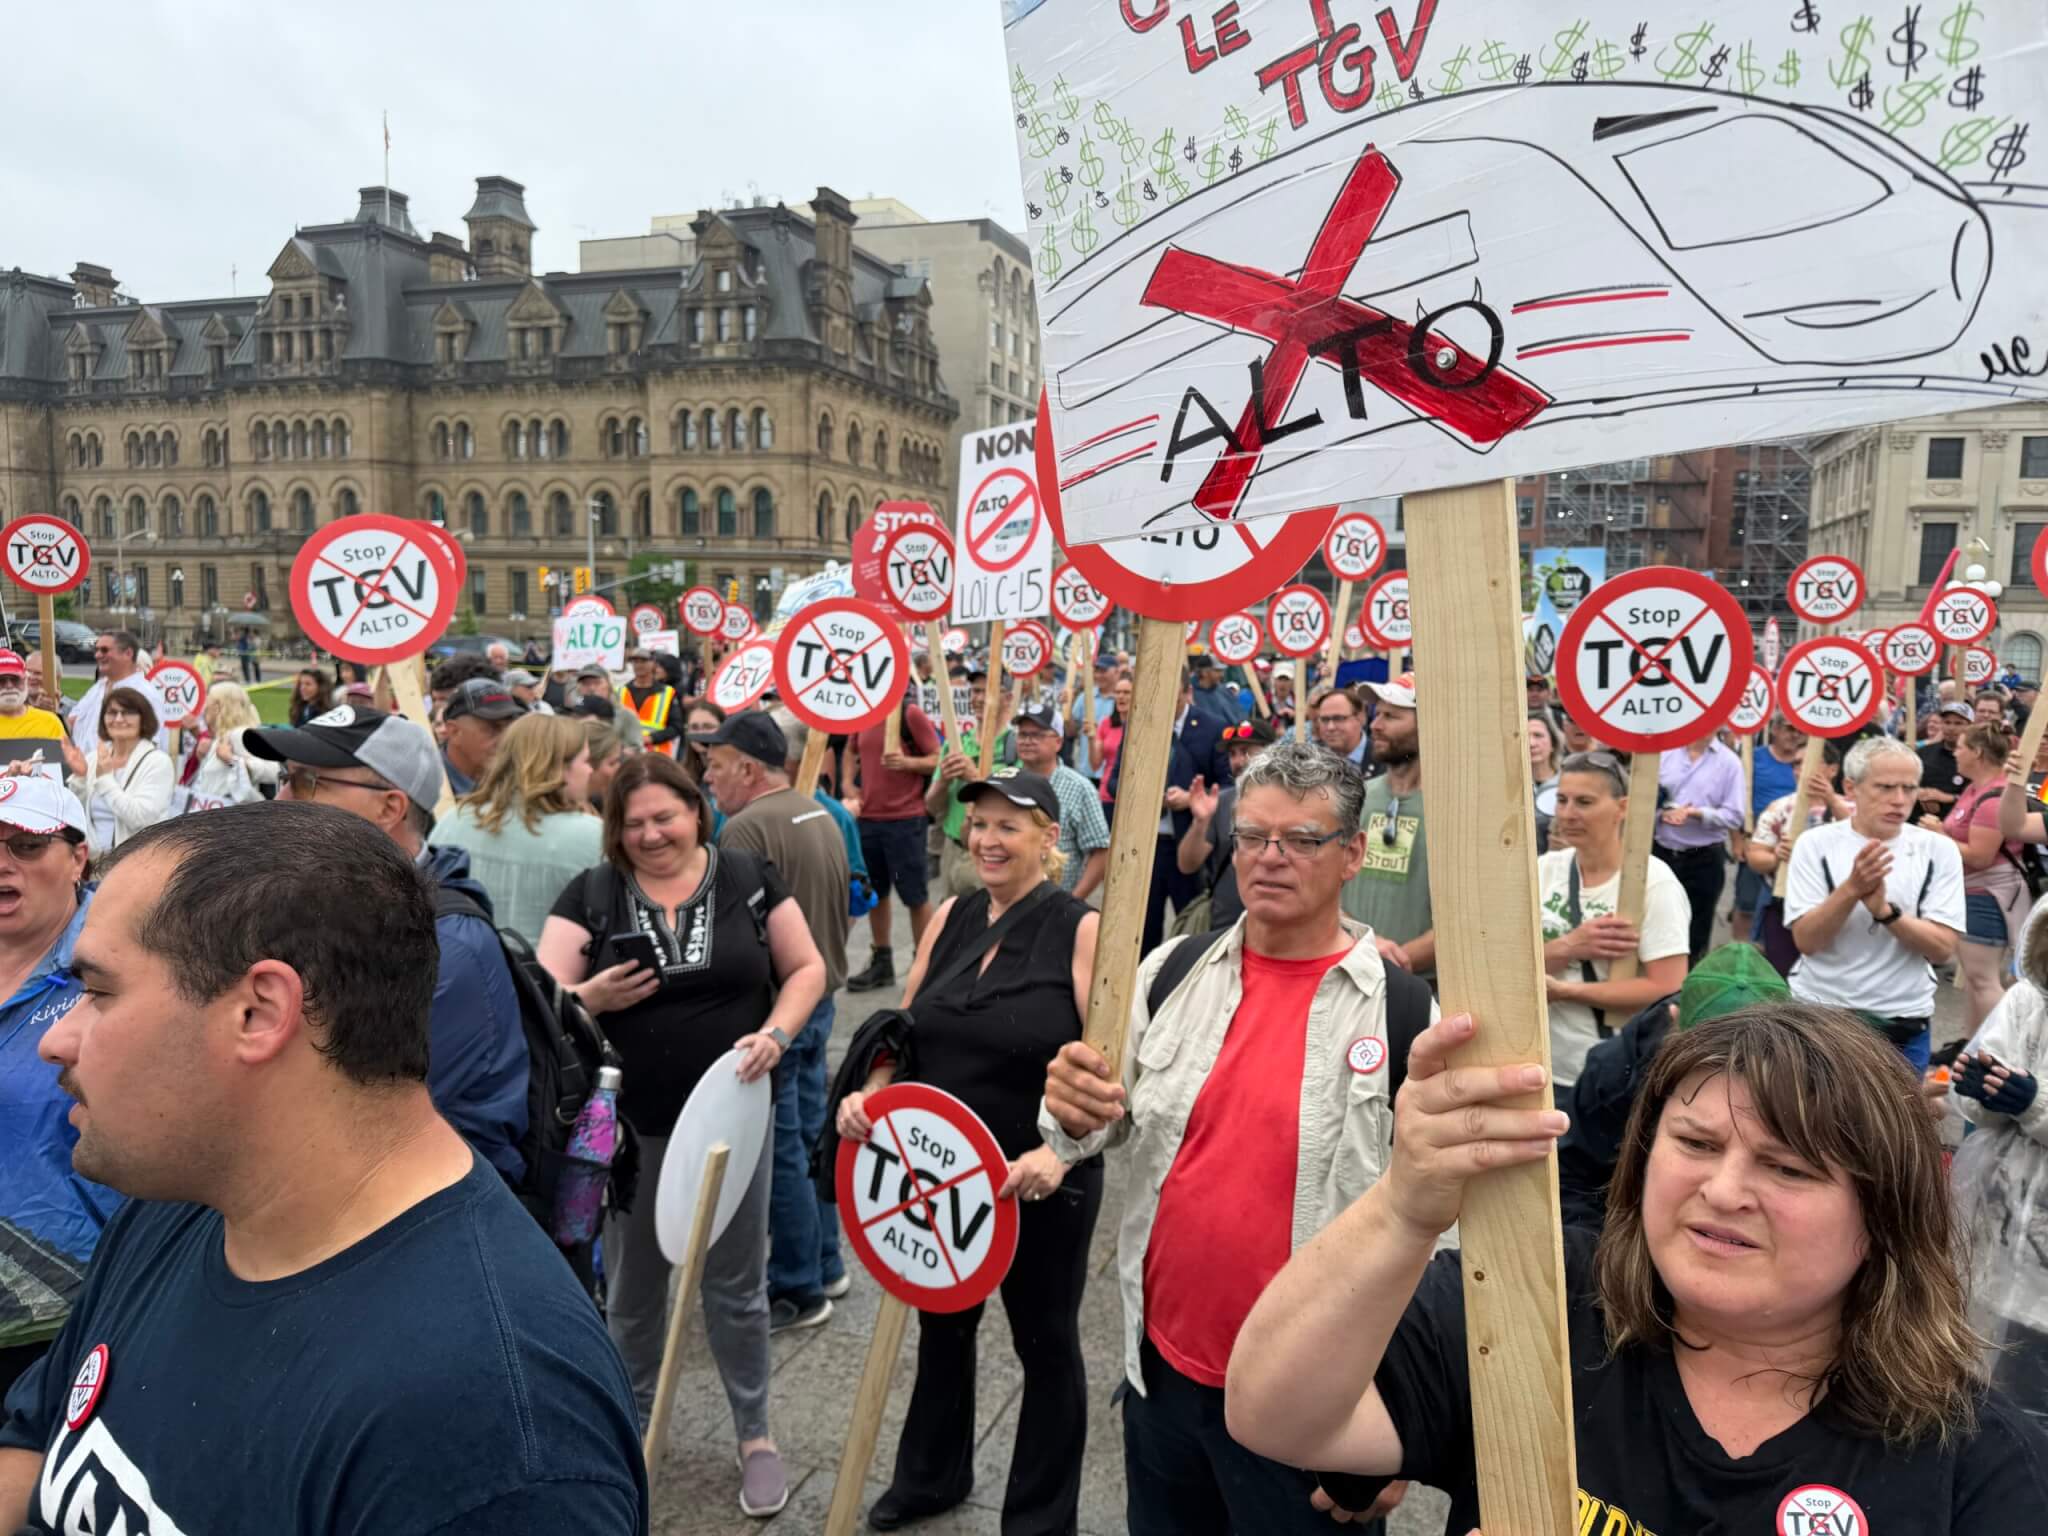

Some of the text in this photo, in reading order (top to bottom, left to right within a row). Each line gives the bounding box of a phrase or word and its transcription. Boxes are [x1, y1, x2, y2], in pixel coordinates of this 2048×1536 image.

[1177, 0, 1252, 74] LE
[1254, 0, 1438, 130] TGV
[1160, 299, 1504, 483] ALTO
[976, 425, 1036, 464] NON
[873, 511, 936, 532] STOP
[30, 530, 55, 542] Stop
[1335, 533, 1378, 560] TGV
[10, 543, 76, 566] TGV
[343, 545, 387, 562] Stop
[905, 543, 929, 555] Stop
[31, 568, 59, 579] ALTO
[890, 556, 948, 588] TGV
[1816, 568, 1838, 577] Stop
[313, 559, 427, 617] TGV
[911, 590, 938, 602] ALTO
[995, 568, 1043, 615] C-15
[1799, 579, 1855, 600] TGV
[687, 603, 720, 618] TGV
[1375, 599, 1408, 621] TG
[1628, 607, 1680, 627] Stop
[1813, 602, 1838, 611] ALTO
[1936, 607, 1986, 624] TGV
[360, 613, 409, 636] ALTO
[1276, 611, 1321, 632] TGV
[829, 623, 865, 642] Stop
[1215, 624, 1253, 650] TGV
[1004, 644, 1040, 660] TGV
[1888, 641, 1933, 657] TGV
[797, 640, 893, 690] TGV
[1584, 634, 1726, 690] TGV
[1819, 656, 1849, 671] Stop
[1967, 660, 1991, 673] GV
[722, 664, 770, 689] TGV
[1795, 670, 1869, 704] TGV
[814, 689, 857, 708] ALTO
[1622, 696, 1682, 716] ALTO
[1738, 688, 1767, 709] GV
[1808, 705, 1843, 718] ALTO
[1365, 850, 1408, 871] STOUT
[908, 1126, 956, 1168] Stop
[865, 1140, 993, 1253] TGV
[882, 1226, 939, 1270] ALTO
[1806, 1497, 1832, 1509] Stop
[1786, 1511, 1854, 1536] TGV
